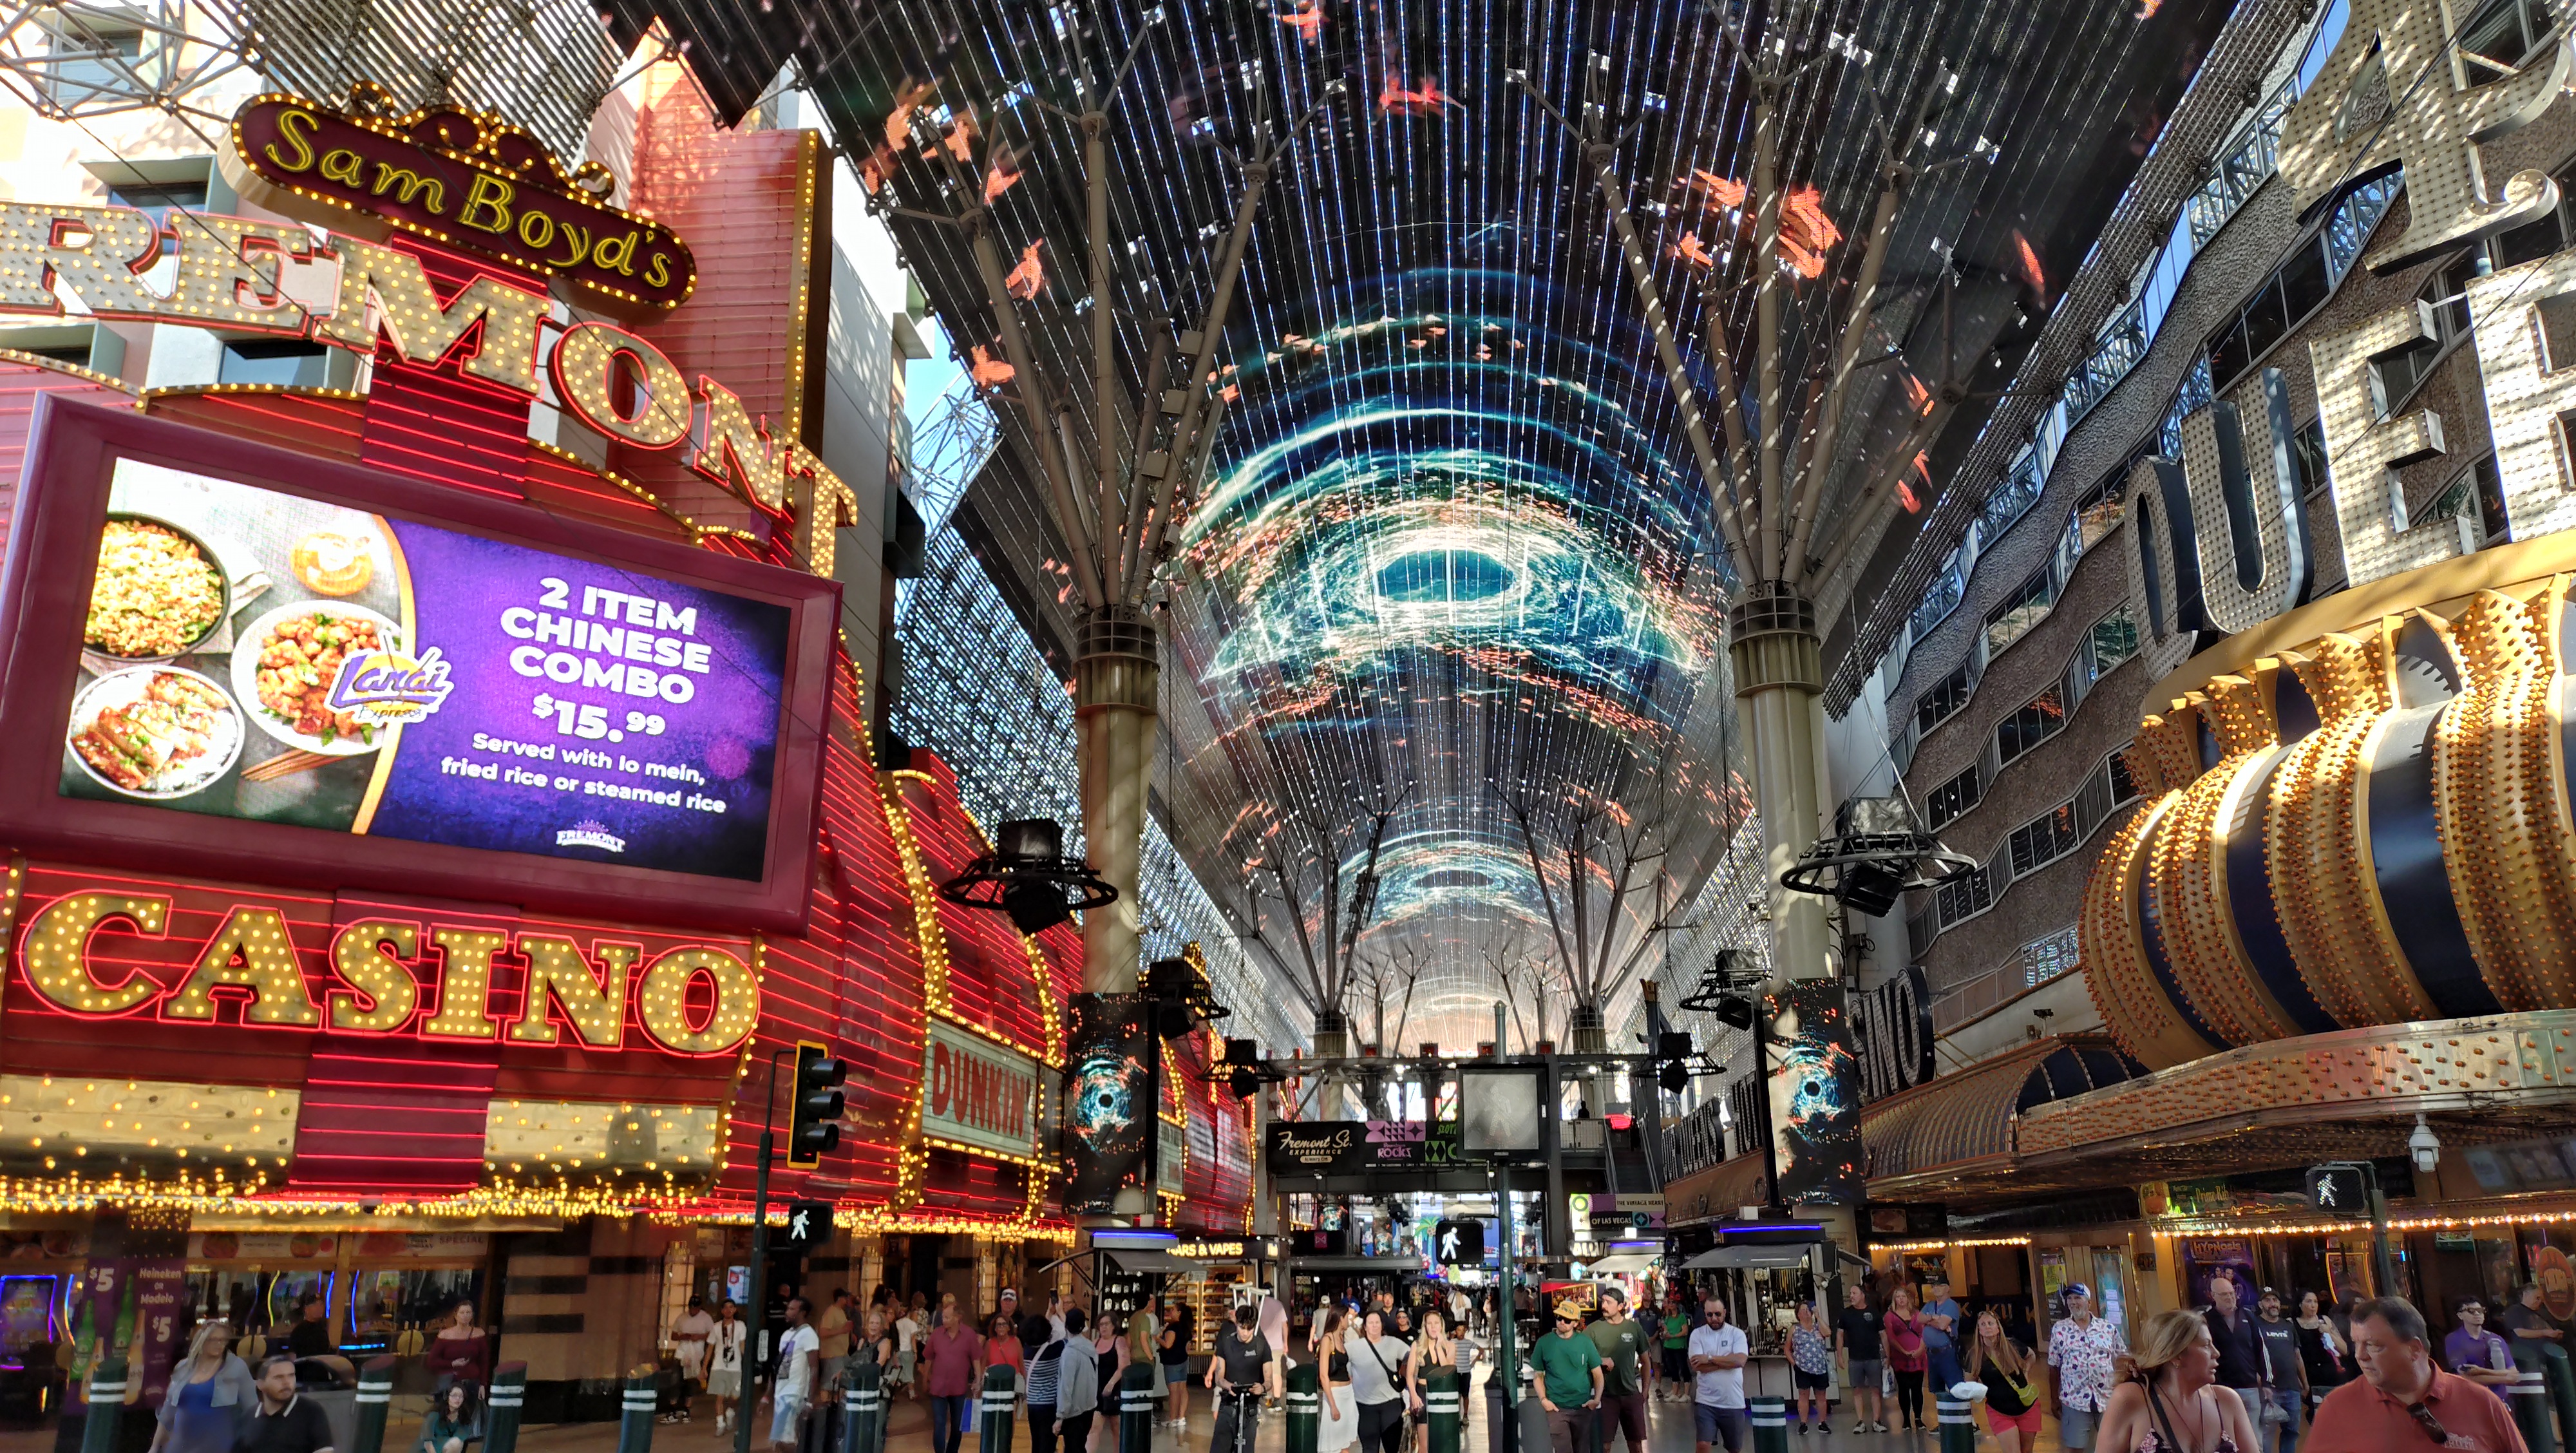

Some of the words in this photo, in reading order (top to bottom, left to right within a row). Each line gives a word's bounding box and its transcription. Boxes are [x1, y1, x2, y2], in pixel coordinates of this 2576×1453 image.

[265, 108, 446, 216] Sam
[460, 171, 674, 289] Boyd's
[539, 577, 570, 610] 2
[582, 585, 697, 636] ITEM
[501, 607, 712, 674] CHINESE
[509, 645, 695, 703] COMBO
[532, 692, 666, 743] $15.99
[441, 756, 498, 781] fried
[504, 766, 548, 788] rice
[554, 776, 579, 792] or
[584, 777, 681, 808] steamed
[687, 792, 726, 813] rice
[473, 732, 555, 760] Served
[562, 748, 612, 769] with
[619, 755, 639, 774] lo
[645, 761, 705, 786] mein,
[556, 830, 626, 853] FREMONT
[19, 890, 761, 1057] CASINO
[932, 1041, 1030, 1138] DUNKIN'
[1278, 1130, 1331, 1151] Fremont
[1332, 1129, 1352, 1148] St.
[1378, 1146, 1412, 1159] ROCKS
[139, 1267, 182, 1279] Heineken
[1198, 1243, 1208, 1257] &
[1209, 1242, 1244, 1256] VAPES
[89, 1267, 115, 1292] $5
[140, 1293, 175, 1305] Modelo
[151, 1315, 172, 1342] $5
